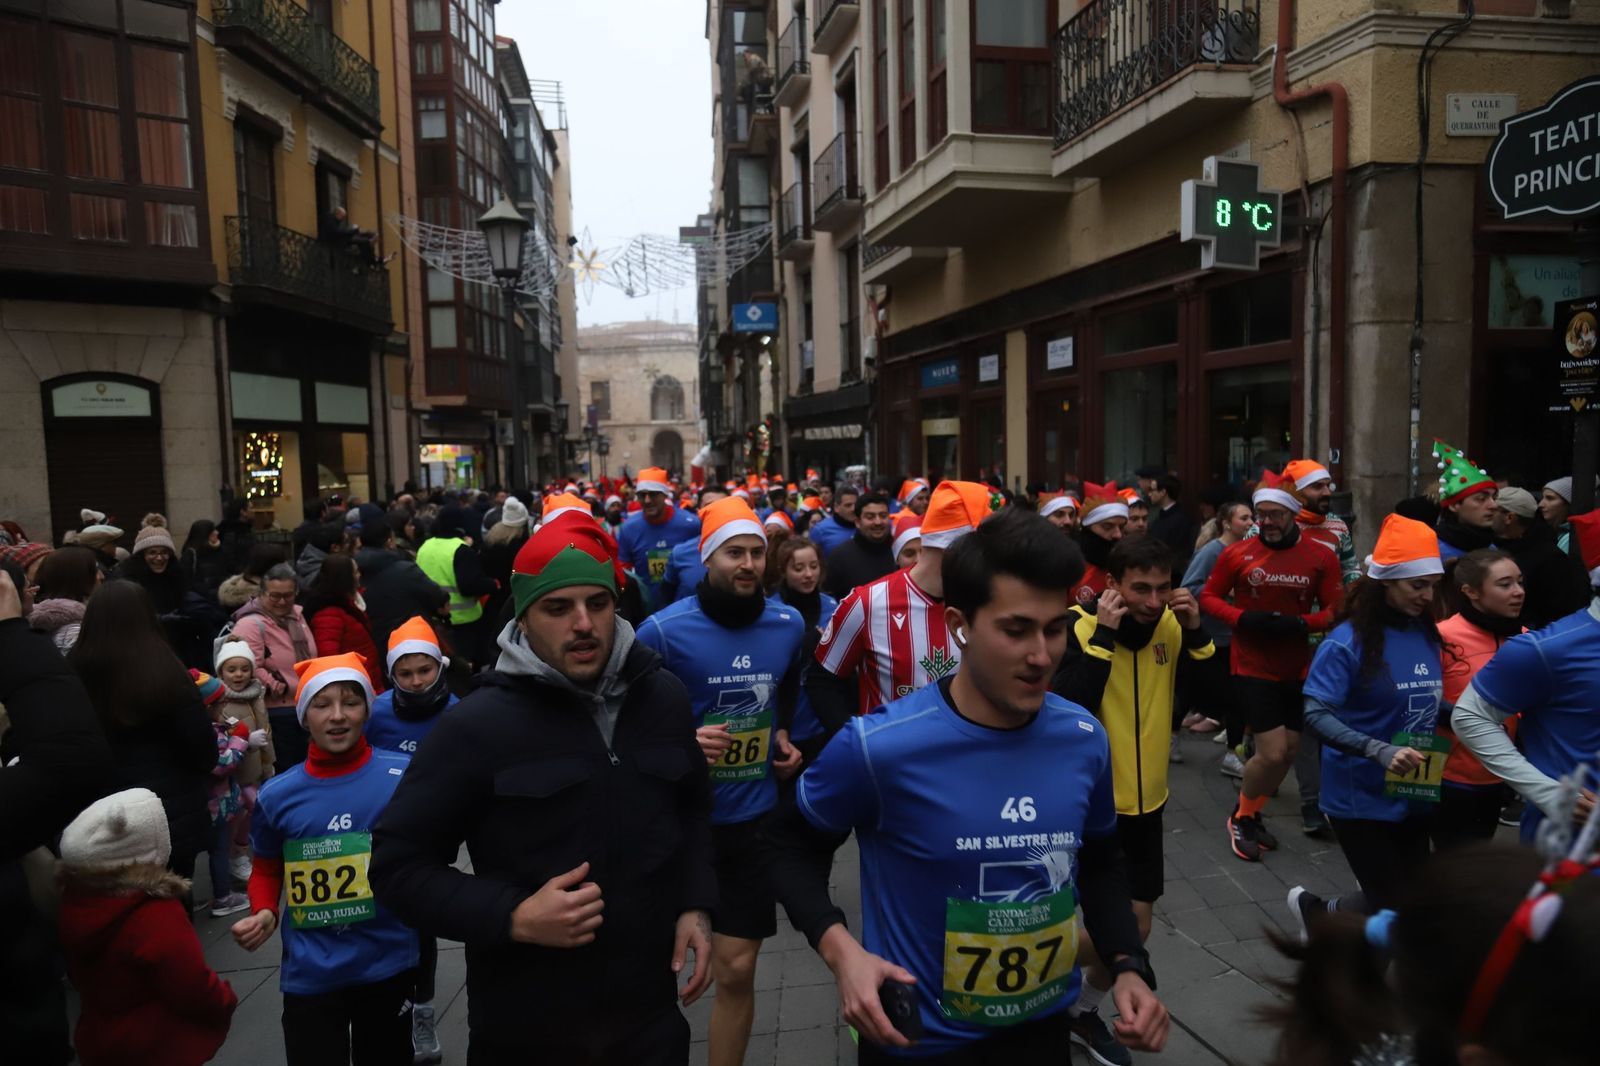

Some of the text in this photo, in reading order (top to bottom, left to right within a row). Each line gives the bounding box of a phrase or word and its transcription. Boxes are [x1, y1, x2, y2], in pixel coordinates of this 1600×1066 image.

[1472, 100, 1500, 108] CALLE
[1477, 111, 1489, 119] DE
[1529, 111, 1600, 156] TEAT
[1216, 199, 1231, 227] 8
[1534, 267, 1551, 280] Un
[1562, 285, 1577, 297] de
[656, 540, 667, 548] 46
[732, 654, 751, 669] 46
[1414, 663, 1429, 676] 46
[708, 676, 721, 684] SAN
[723, 674, 756, 683] SILVESTRE
[1396, 682, 1409, 690] SAN
[399, 740, 417, 752] 46
[716, 767, 762, 778] CAJA RURAL
[1000, 796, 1037, 823] 46
[327, 813, 352, 831] 46
[956, 831, 1075, 850] SAN SILVESTRE 2025
[290, 865, 358, 904] 582
[307, 905, 369, 920] CAJA RURAL
[988, 913, 1051, 927] CAJA RURAL
[957, 935, 1063, 992] 787
[984, 984, 1064, 1017] CAJA RURAL
